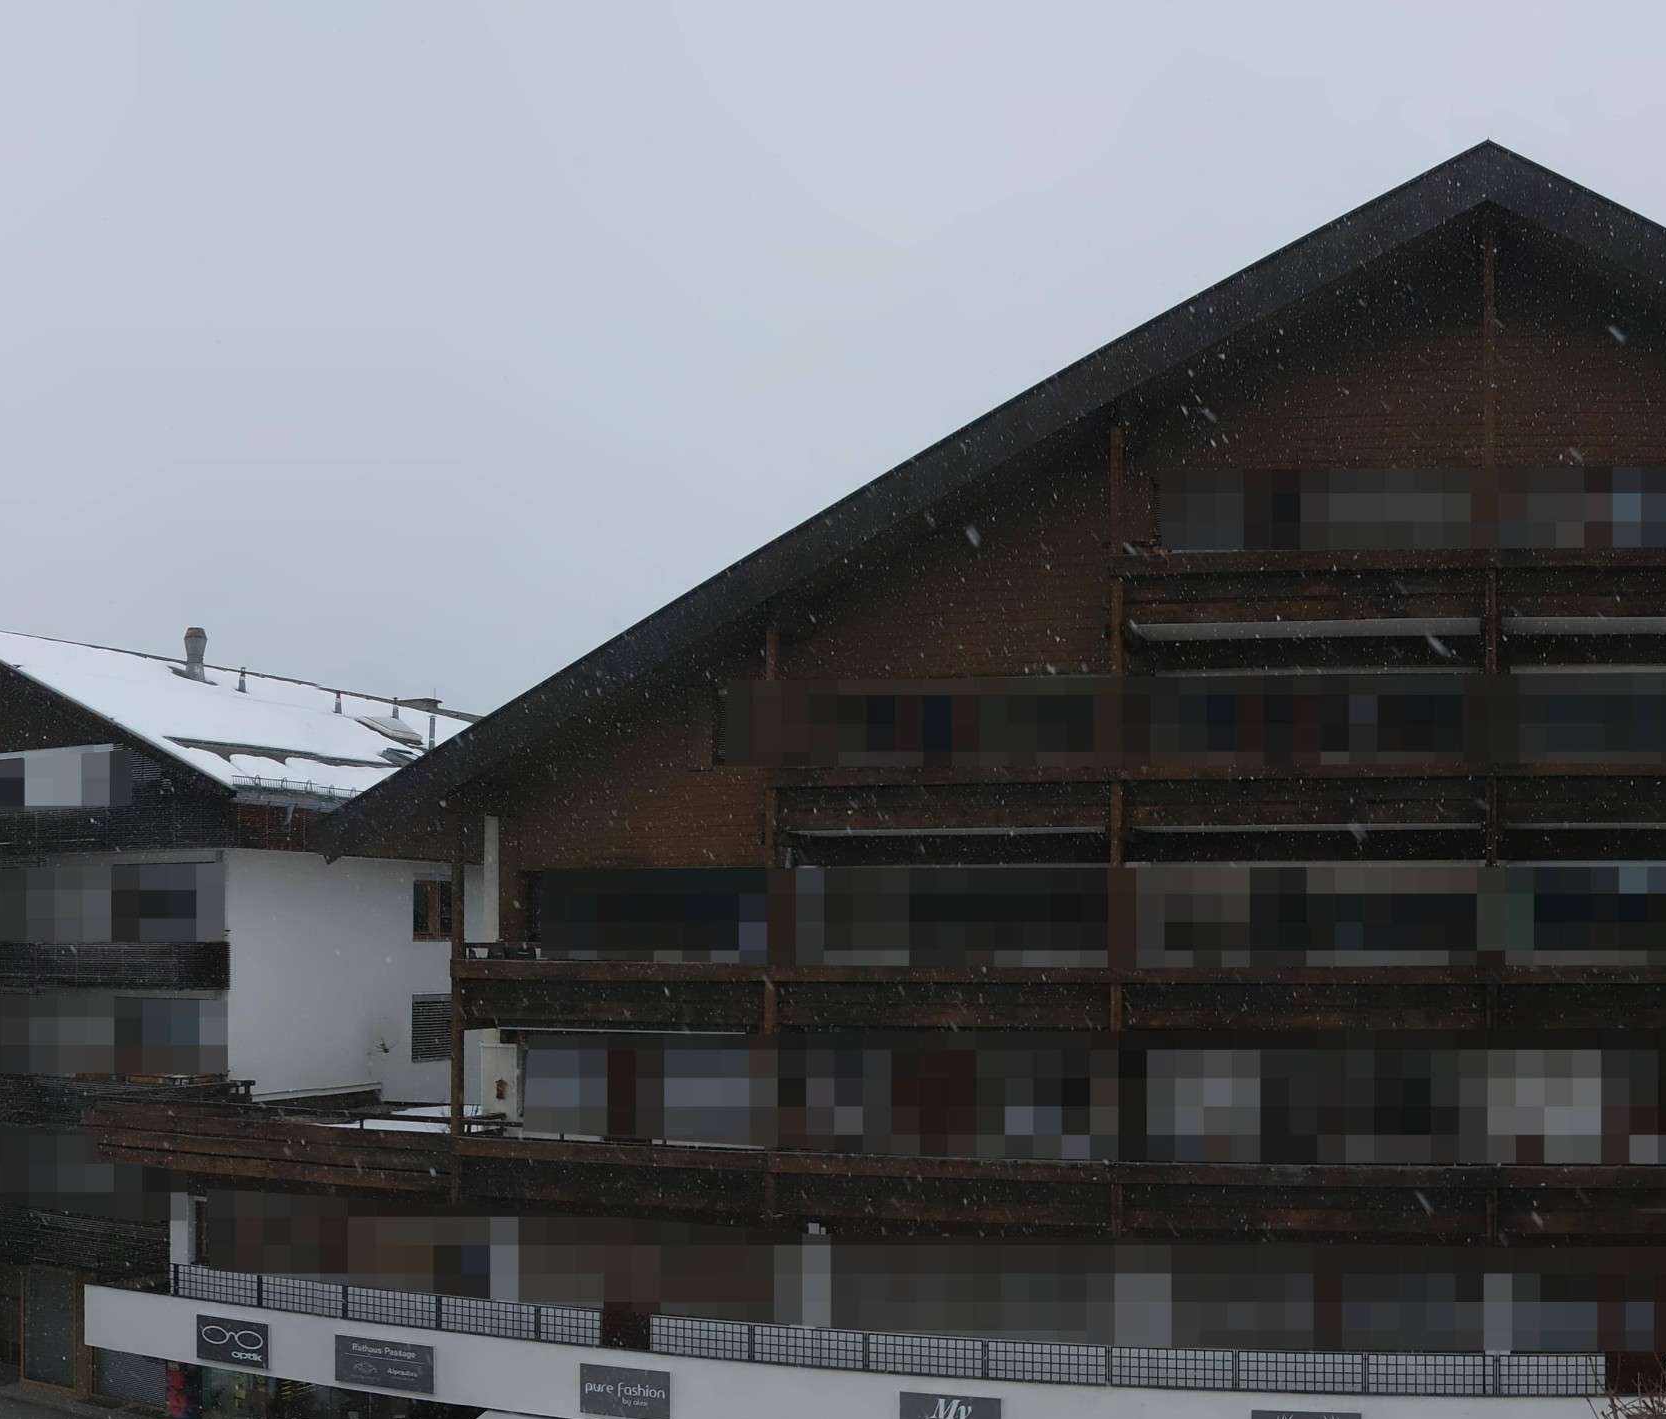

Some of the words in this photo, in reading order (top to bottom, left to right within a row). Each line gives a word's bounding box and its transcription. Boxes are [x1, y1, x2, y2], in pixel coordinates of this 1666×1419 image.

[231, 1350, 263, 1362] optik
[352, 1342, 382, 1355] Rathaus
[384, 1346, 416, 1360] Passage
[585, 1382, 614, 1394] pure
[617, 1382, 666, 1399] fashion
[622, 1397, 632, 1407] by
